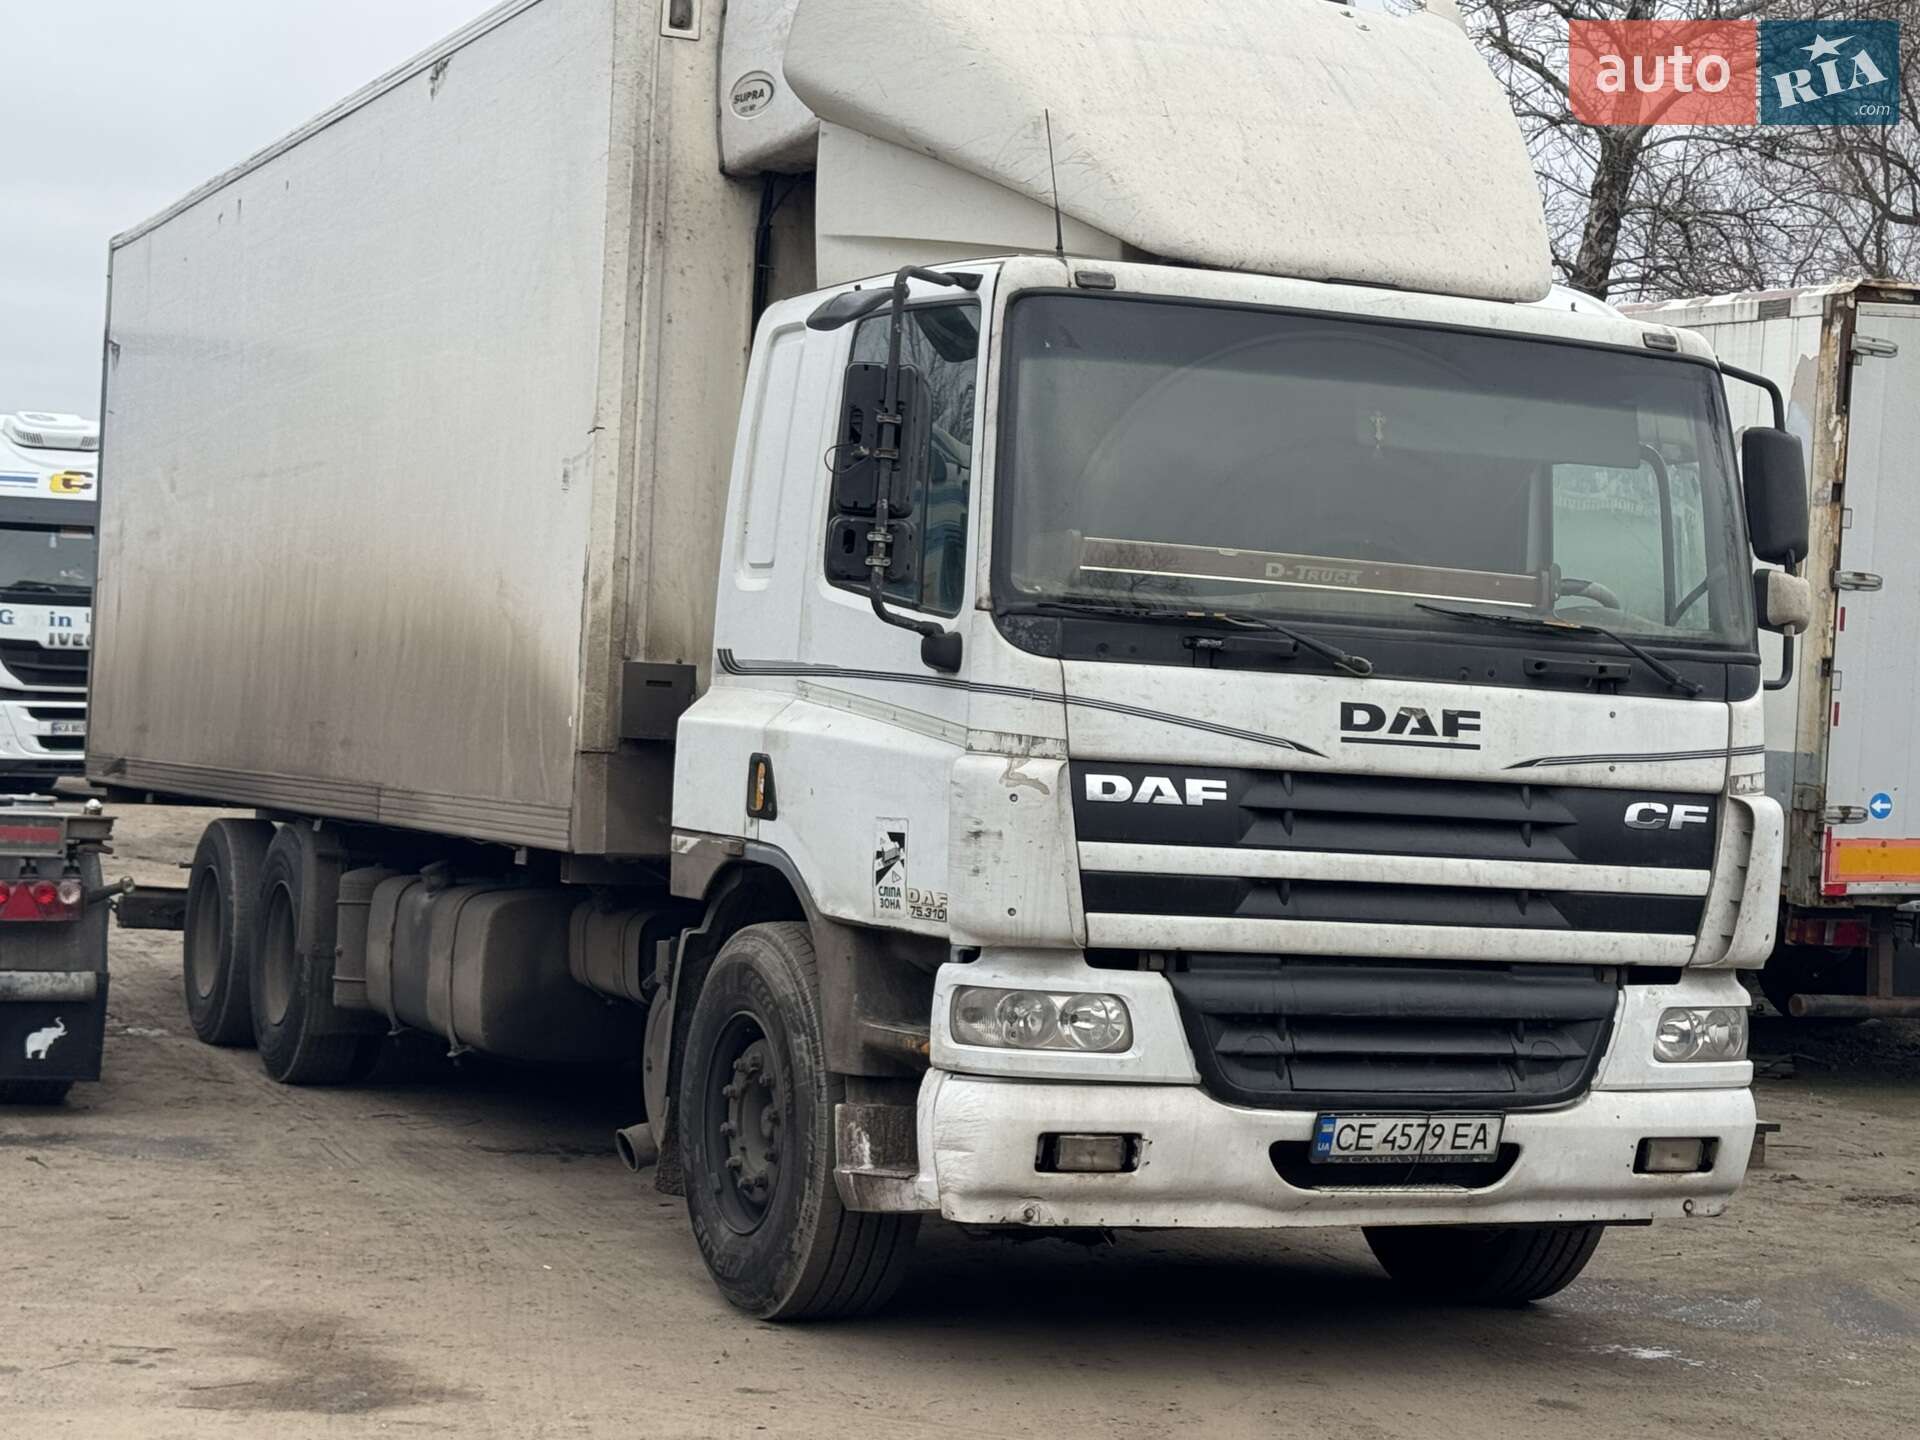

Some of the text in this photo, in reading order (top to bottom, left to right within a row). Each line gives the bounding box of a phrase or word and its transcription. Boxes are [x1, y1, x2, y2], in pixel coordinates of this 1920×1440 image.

[732, 88, 765, 104] SUPRA
[48, 632, 92, 647] IVE
[1340, 702, 1481, 738] DAF
[1085, 773, 1228, 806] DAF
[1623, 801, 1710, 832] CF
[878, 886, 901, 898] СЛІПА
[908, 888, 948, 908] DAF
[880, 898, 901, 910] ЗОНА
[1336, 1123, 1488, 1151] CE 4579 EA
[1318, 1143, 1330, 1151] UA
